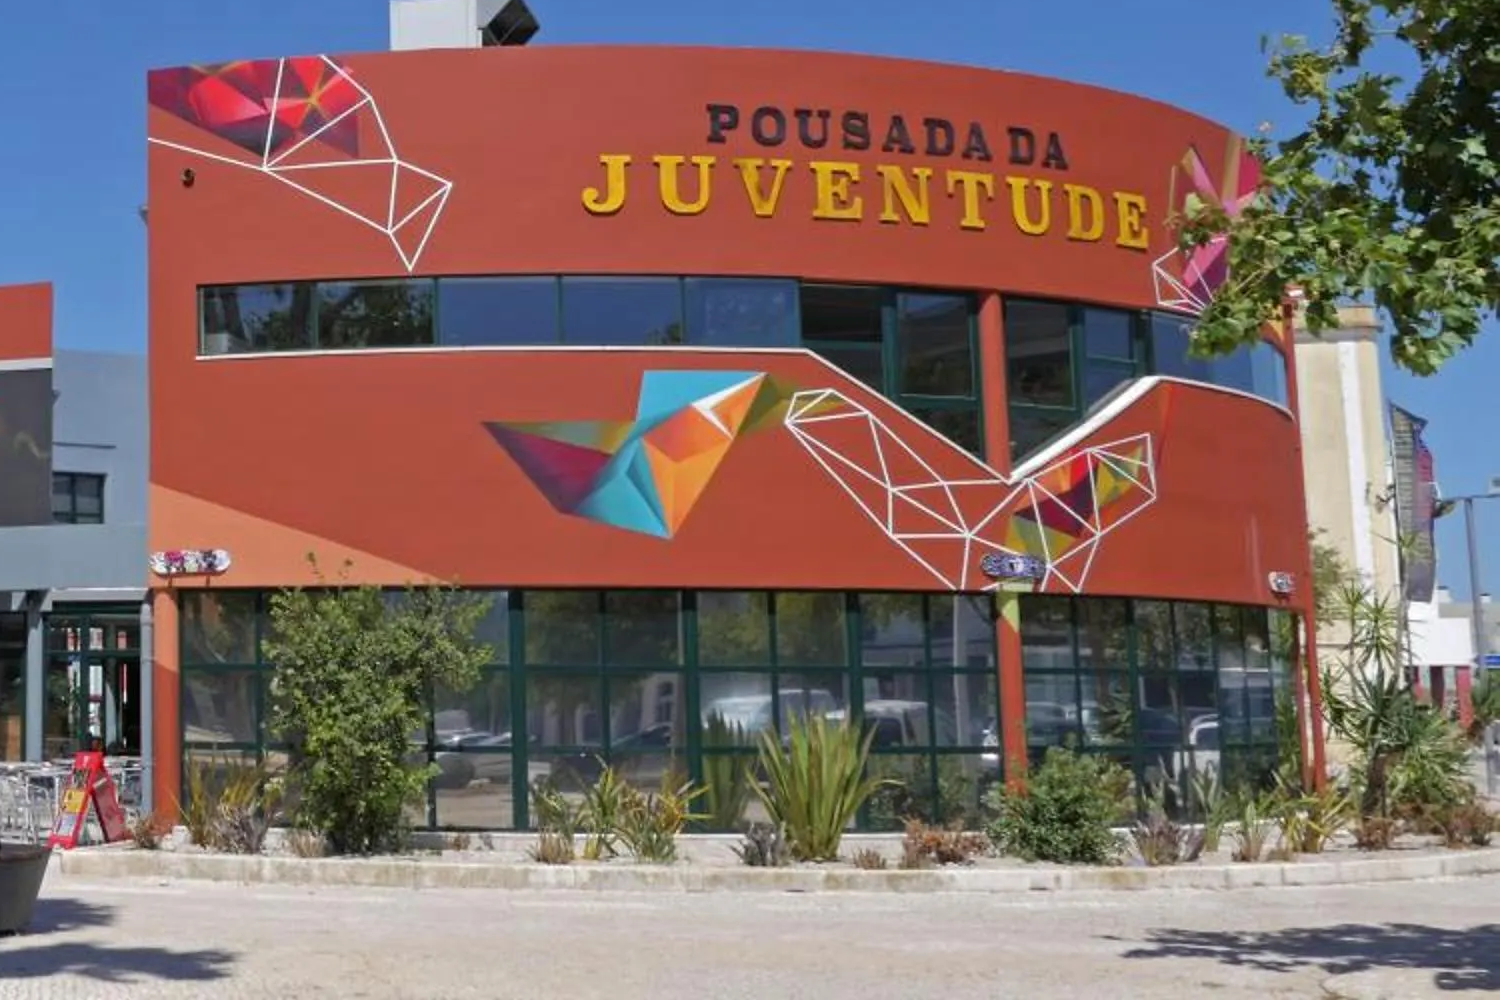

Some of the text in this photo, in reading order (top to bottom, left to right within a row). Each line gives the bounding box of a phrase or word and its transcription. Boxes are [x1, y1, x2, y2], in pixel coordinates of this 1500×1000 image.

[706, 103, 1068, 170] POUSADA DA
[582, 154, 1150, 250] JUVENTUDE
